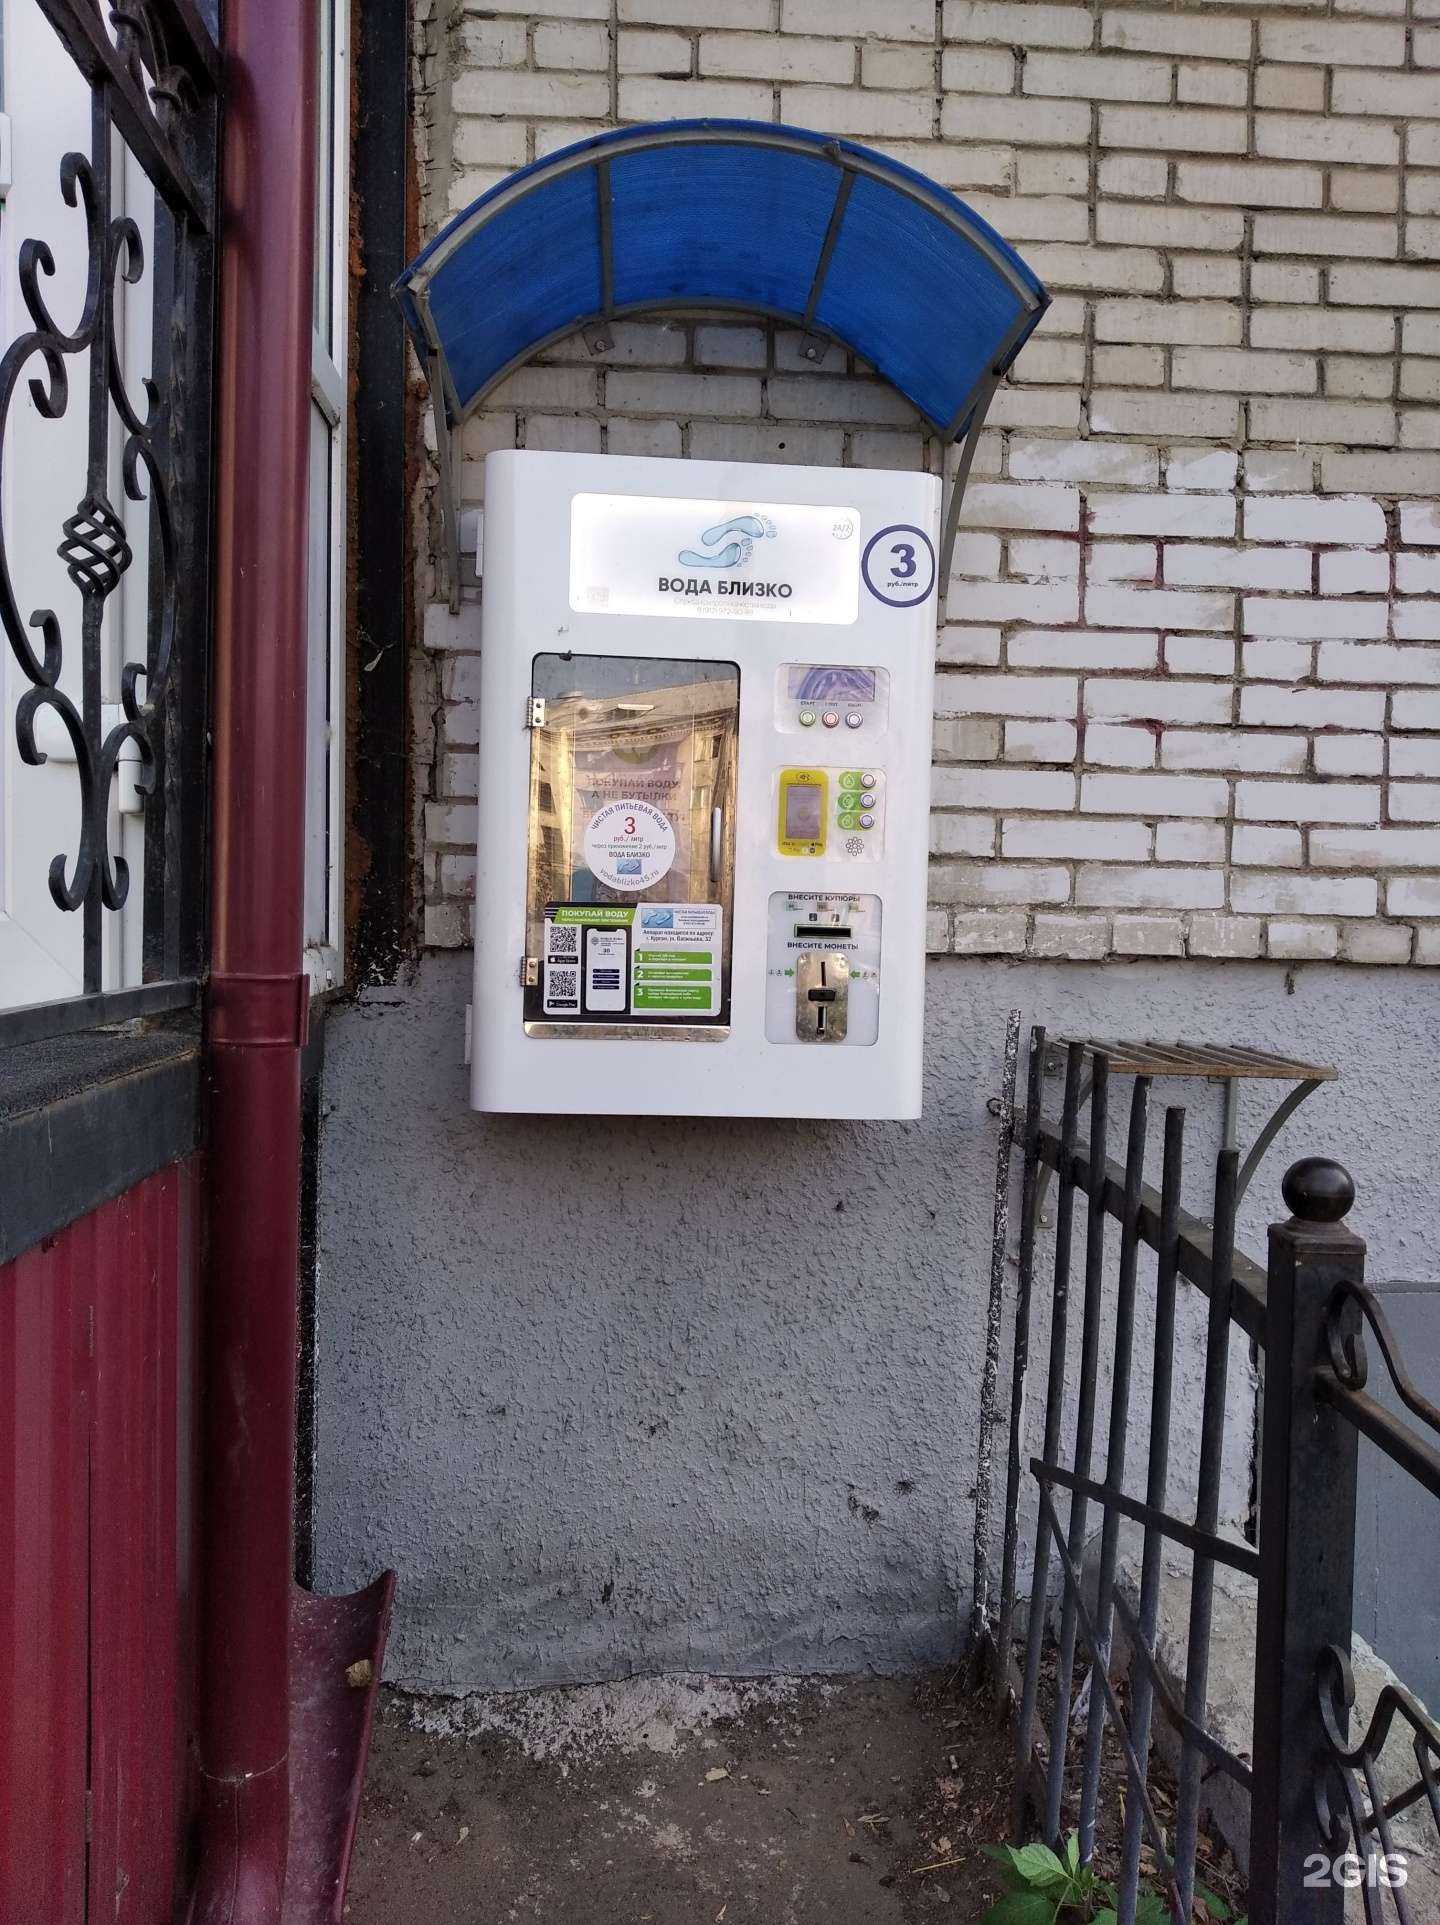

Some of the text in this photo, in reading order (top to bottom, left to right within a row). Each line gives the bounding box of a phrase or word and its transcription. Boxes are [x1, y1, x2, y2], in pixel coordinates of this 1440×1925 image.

[889, 543, 917, 578] 3
[658, 577, 793, 598] ВОДА БЛИЗКО
[592, 791, 600, 800] А
[603, 791, 619, 800] НЕ
[591, 807, 615, 831] ЧИСТАЯ
[615, 802, 653, 816] ПИТЬЕВАЯ
[653, 812, 668, 833] ВОДА
[624, 816, 636, 834] 3
[600, 867, 660, 886] vodablizko45.ru
[561, 910, 629, 919] ПОКУПАЙ ВОДУ
[638, 954, 643, 962] 1
[637, 971, 644, 979] 2
[637, 988, 644, 997] 3
